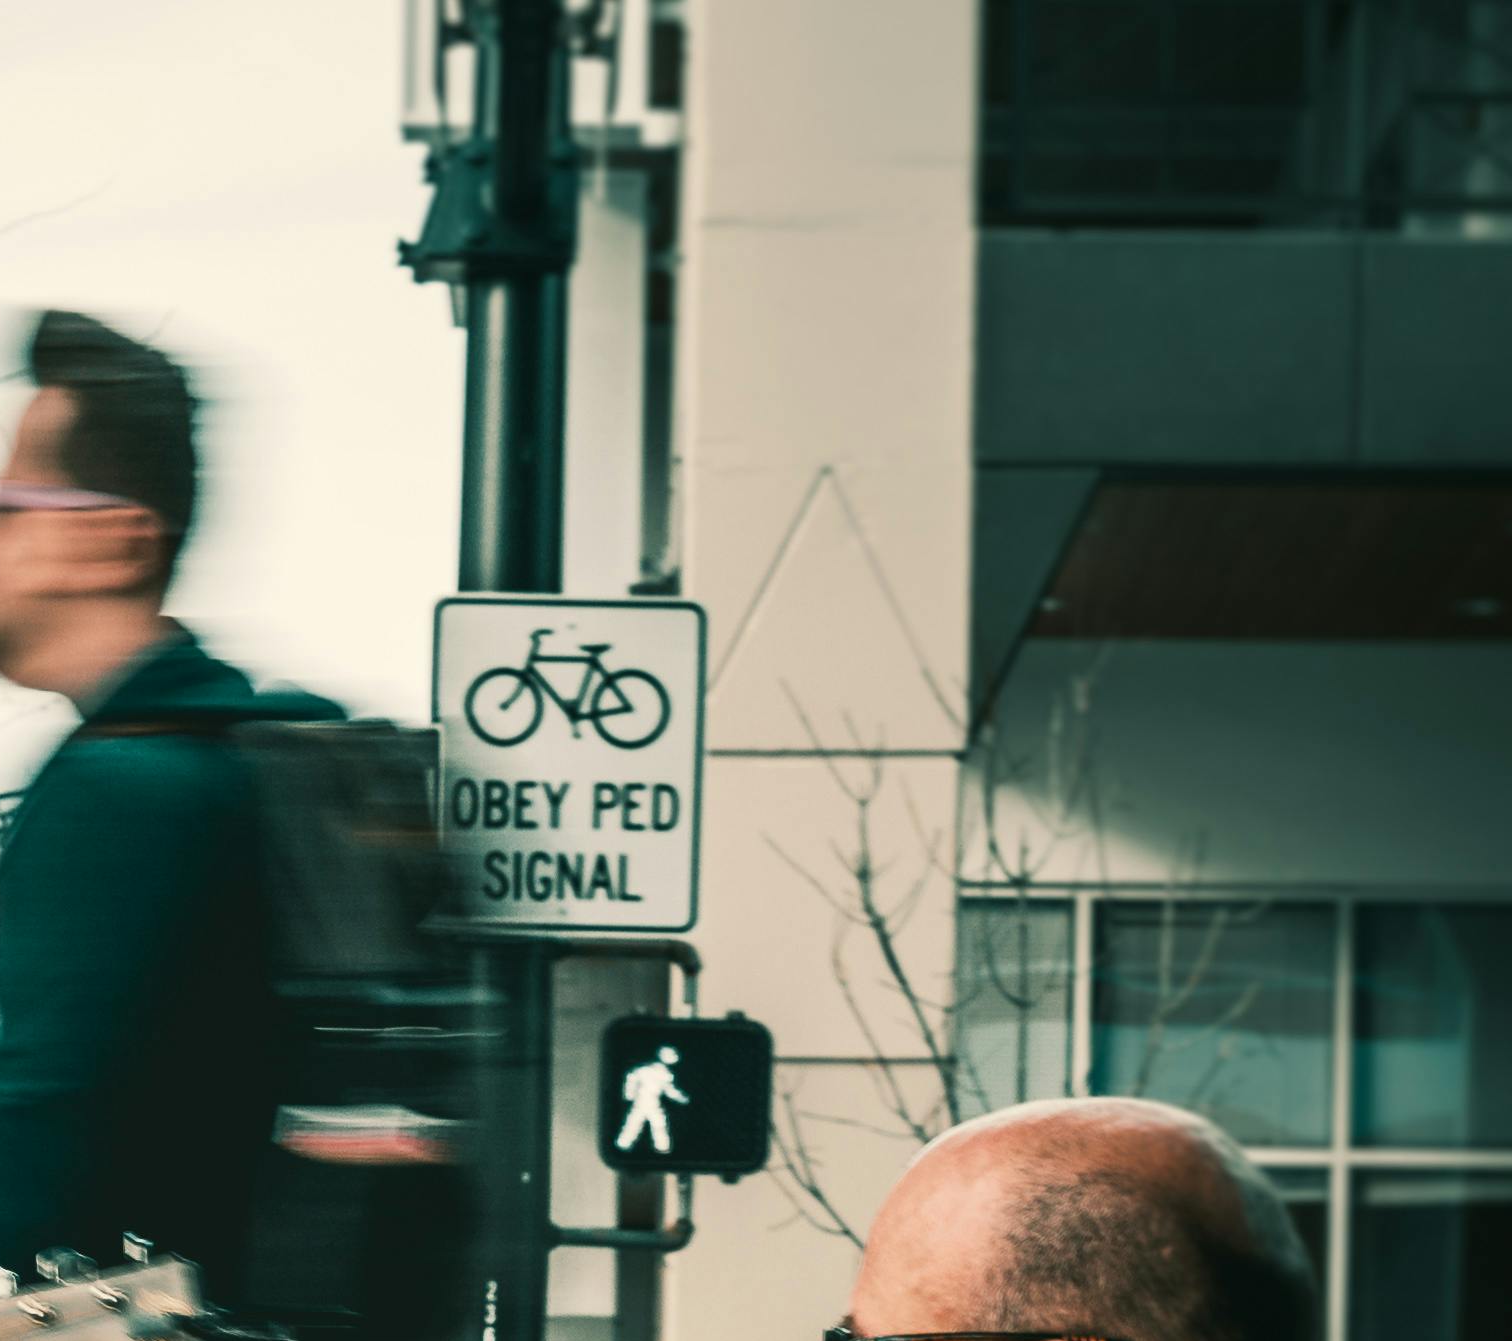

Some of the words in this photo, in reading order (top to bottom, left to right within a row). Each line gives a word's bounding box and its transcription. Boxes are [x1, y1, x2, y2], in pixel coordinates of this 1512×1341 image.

[451, 777, 571, 831] OBEY
[591, 782, 681, 833] PED
[482, 850, 644, 903] SIGNAL
